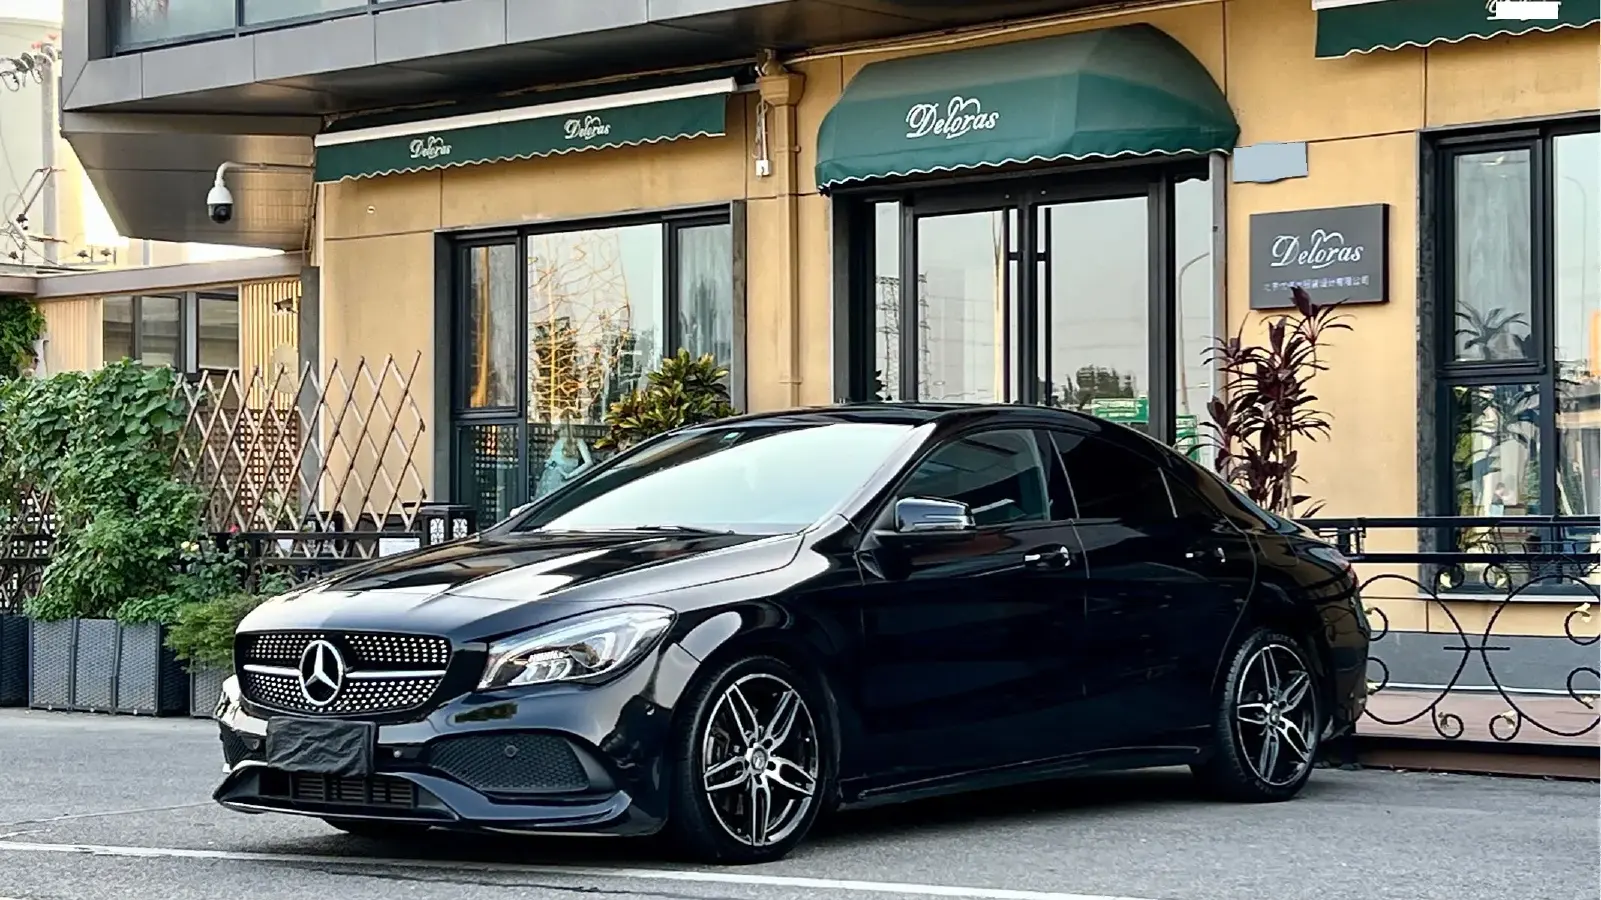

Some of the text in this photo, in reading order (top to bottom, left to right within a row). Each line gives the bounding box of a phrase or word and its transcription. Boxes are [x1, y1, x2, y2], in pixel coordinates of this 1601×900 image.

[564, 115, 611, 140] Deloras
[906, 96, 1000, 139] Deloras
[409, 136, 452, 159] Deloras
[1270, 229, 1364, 269] Deloras
